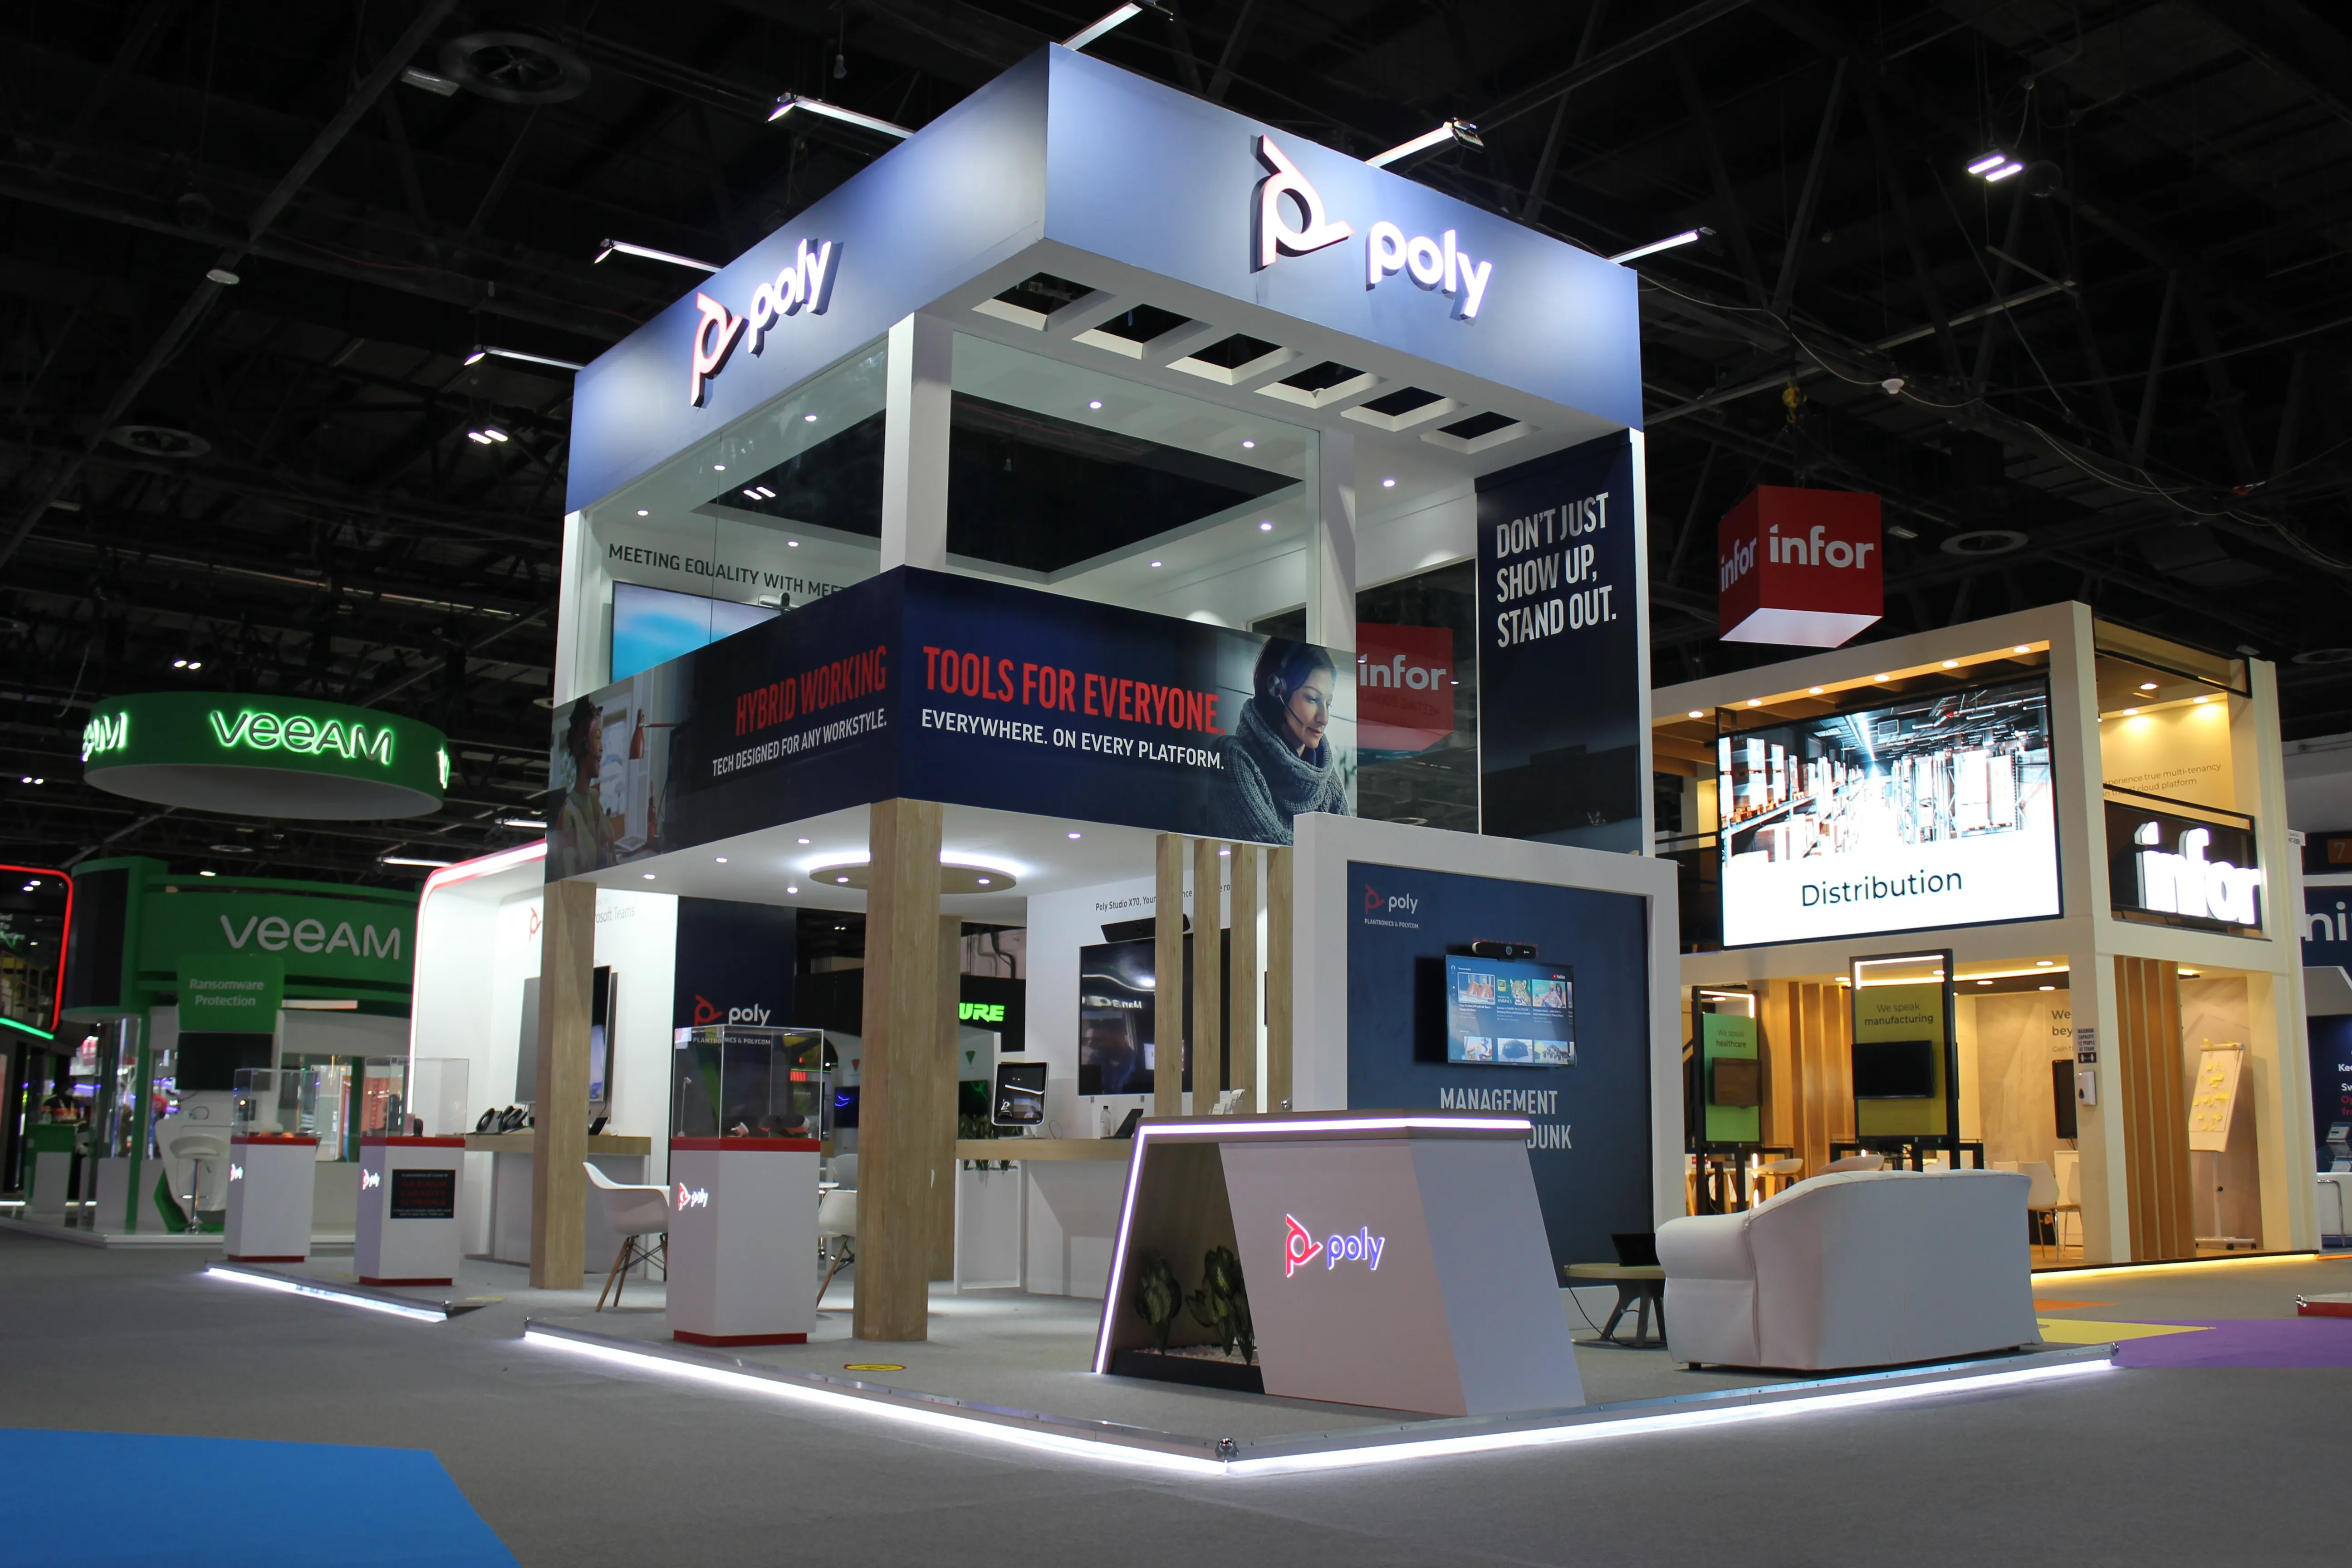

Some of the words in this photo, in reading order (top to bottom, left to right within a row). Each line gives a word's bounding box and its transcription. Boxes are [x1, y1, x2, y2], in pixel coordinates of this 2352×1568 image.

[1368, 221, 1491, 318] poly
[748, 238, 832, 355] poly
[1496, 508, 1554, 559] DON'T
[1560, 492, 1608, 541] JUST
[1769, 524, 1875, 569] infor
[608, 543, 680, 570] MEETING
[685, 558, 759, 585] EQUALITY
[764, 572, 803, 594] WITH
[807, 581, 846, 597] MEE
[1496, 552, 1559, 603] SHOW
[1565, 544, 1597, 584] UP,
[1720, 537, 1757, 593] infor
[1497, 598, 1564, 648] STAND
[1569, 585, 1617, 630] OUT.
[1360, 653, 1447, 690] infor
[735, 678, 796, 736] HYBRID
[800, 645, 887, 715] WORKING
[923, 646, 1014, 702] TOOLS
[1022, 662, 1077, 712] FOR
[1084, 673, 1225, 735] EVERYONE.
[713, 756, 734, 776] TECH
[735, 740, 779, 770] DESIGNED
[782, 735, 799, 757] FOR
[801, 728, 821, 751] ANY
[823, 708, 887, 744] WORKSTYLE.
[921, 709, 1048, 745] EVERYWHERE.
[1053, 729, 1076, 749] ON
[1081, 733, 1134, 757] EVERY
[1138, 742, 1224, 769] PLATFORM.
[2105, 776, 2142, 786] xperience
[2144, 772, 2161, 780] true
[2163, 764, 2221, 778] multi-tenancy
[2137, 783, 2159, 792] cloud
[2161, 777, 2197, 790] platform
[2334, 842, 2346, 859] 7
[2134, 821, 2261, 925] infor
[1802, 869, 1962, 906] Distribution
[614, 906, 635, 920] Teams
[1096, 902, 1107, 912] Poly
[1109, 899, 1127, 909] Studio
[1129, 897, 1141, 906] X70,
[1389, 893, 1418, 914] poly
[1364, 918, 1394, 926] PLANTRONICS
[190, 979, 264, 990] Ransomware
[195, 995, 255, 1006] Protection
[959, 1003, 1004, 1022] URE
[1877, 1004, 1891, 1012] We
[1893, 1003, 1920, 1012] speak
[728, 1003, 771, 1027] poly
[1865, 1014, 1933, 1025] manufacturing
[2051, 1009, 2071, 1019] We
[1716, 1039, 1746, 1048] healthcare
[2052, 1026, 2073, 1038] bey
[1441, 1088, 1558, 1115] MANAGEMENT
[691, 1187, 709, 1208] poly
[1328, 1226, 1385, 1270] poly
